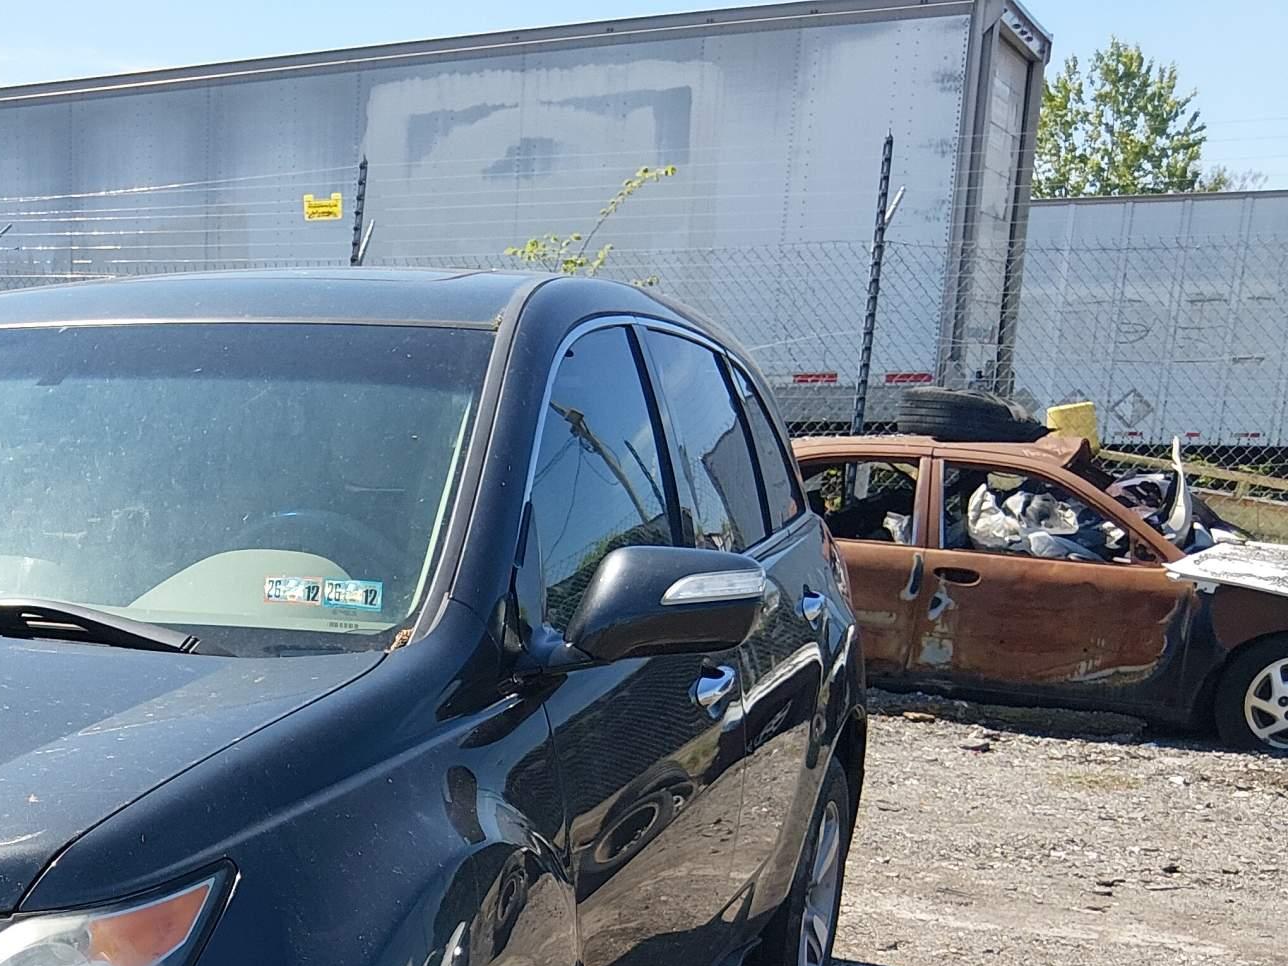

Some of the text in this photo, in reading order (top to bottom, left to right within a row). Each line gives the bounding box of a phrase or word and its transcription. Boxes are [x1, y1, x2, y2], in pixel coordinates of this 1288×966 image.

[267, 579, 320, 601] 26 12
[326, 582, 378, 606] 26 12
